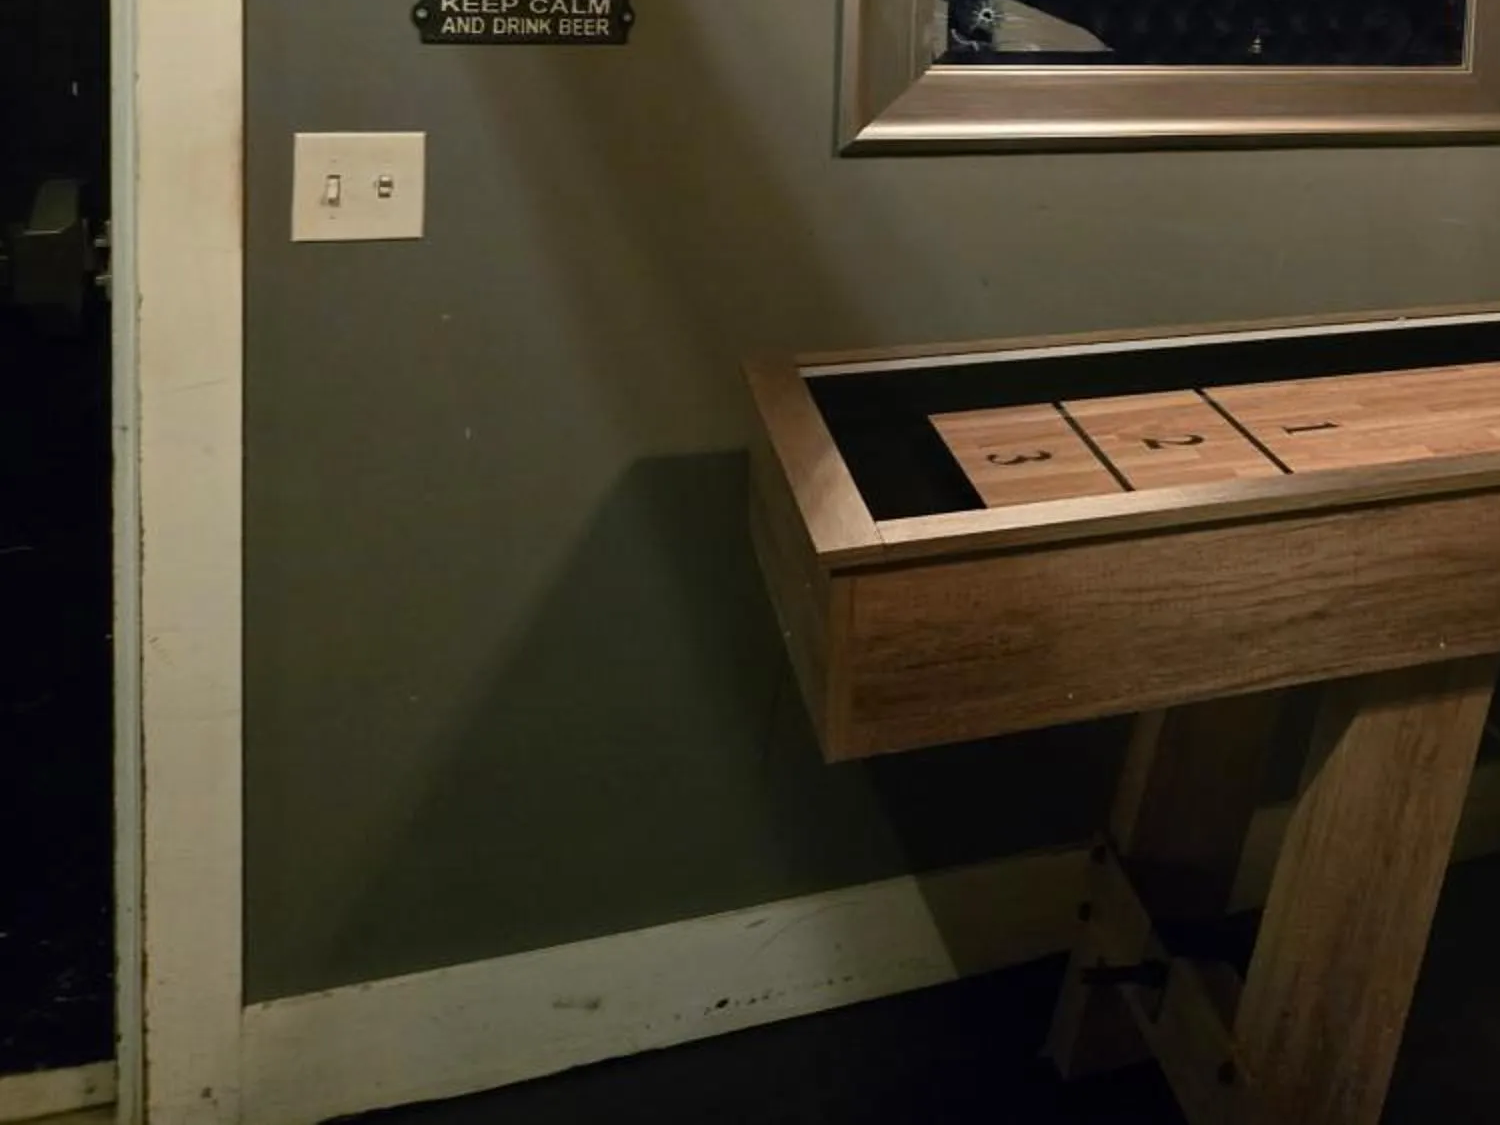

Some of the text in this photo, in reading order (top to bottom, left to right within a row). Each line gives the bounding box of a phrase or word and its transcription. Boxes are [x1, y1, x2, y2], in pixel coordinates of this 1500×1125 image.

[441, 16, 609, 35] AND DRINK BEER
[1142, 434, 1204, 450] 2
[986, 450, 1052, 465] 3
